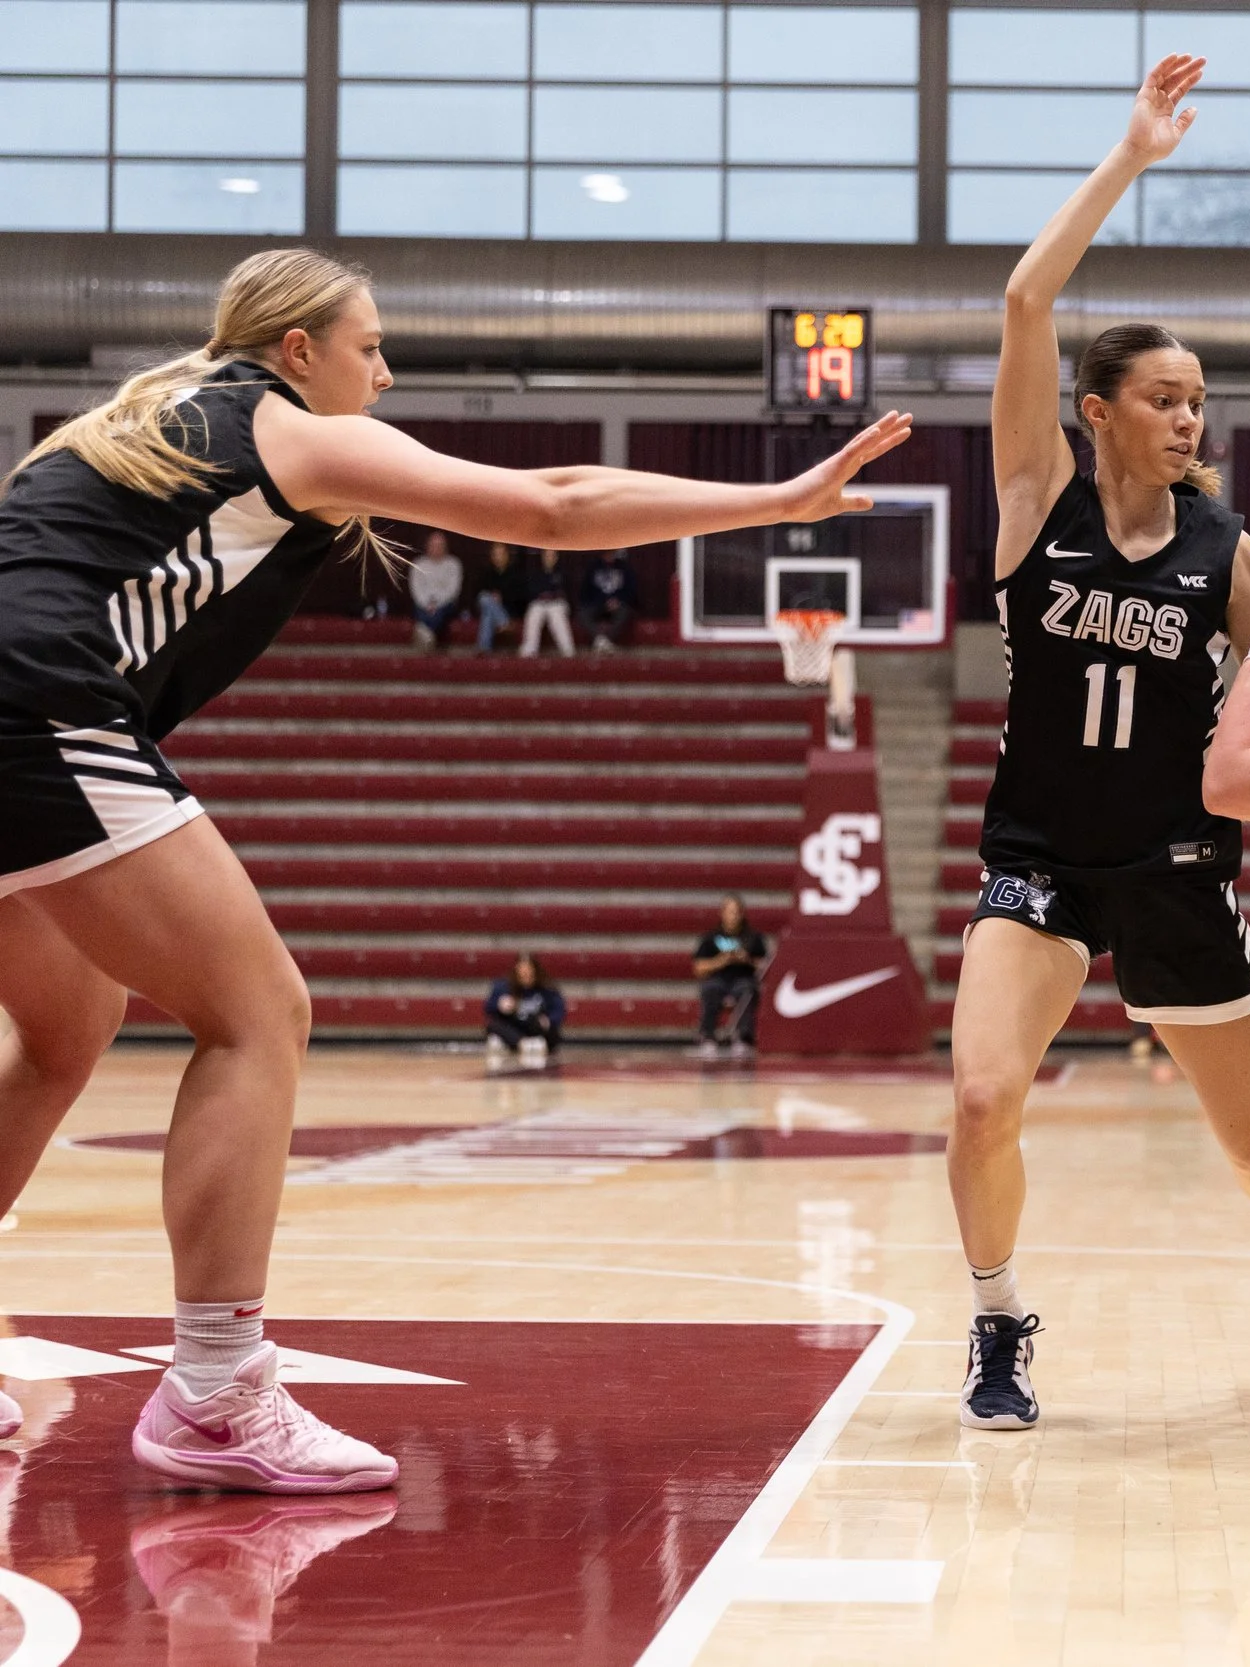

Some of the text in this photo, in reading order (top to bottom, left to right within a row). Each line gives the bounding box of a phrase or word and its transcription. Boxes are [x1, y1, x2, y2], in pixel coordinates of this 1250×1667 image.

[807, 347, 853, 400] 19
[1177, 574, 1207, 587] WCC
[1041, 579, 1188, 661] ZAGS
[1083, 664, 1136, 748] 11
[1202, 846, 1211, 857] M
[988, 876, 1028, 910] G
